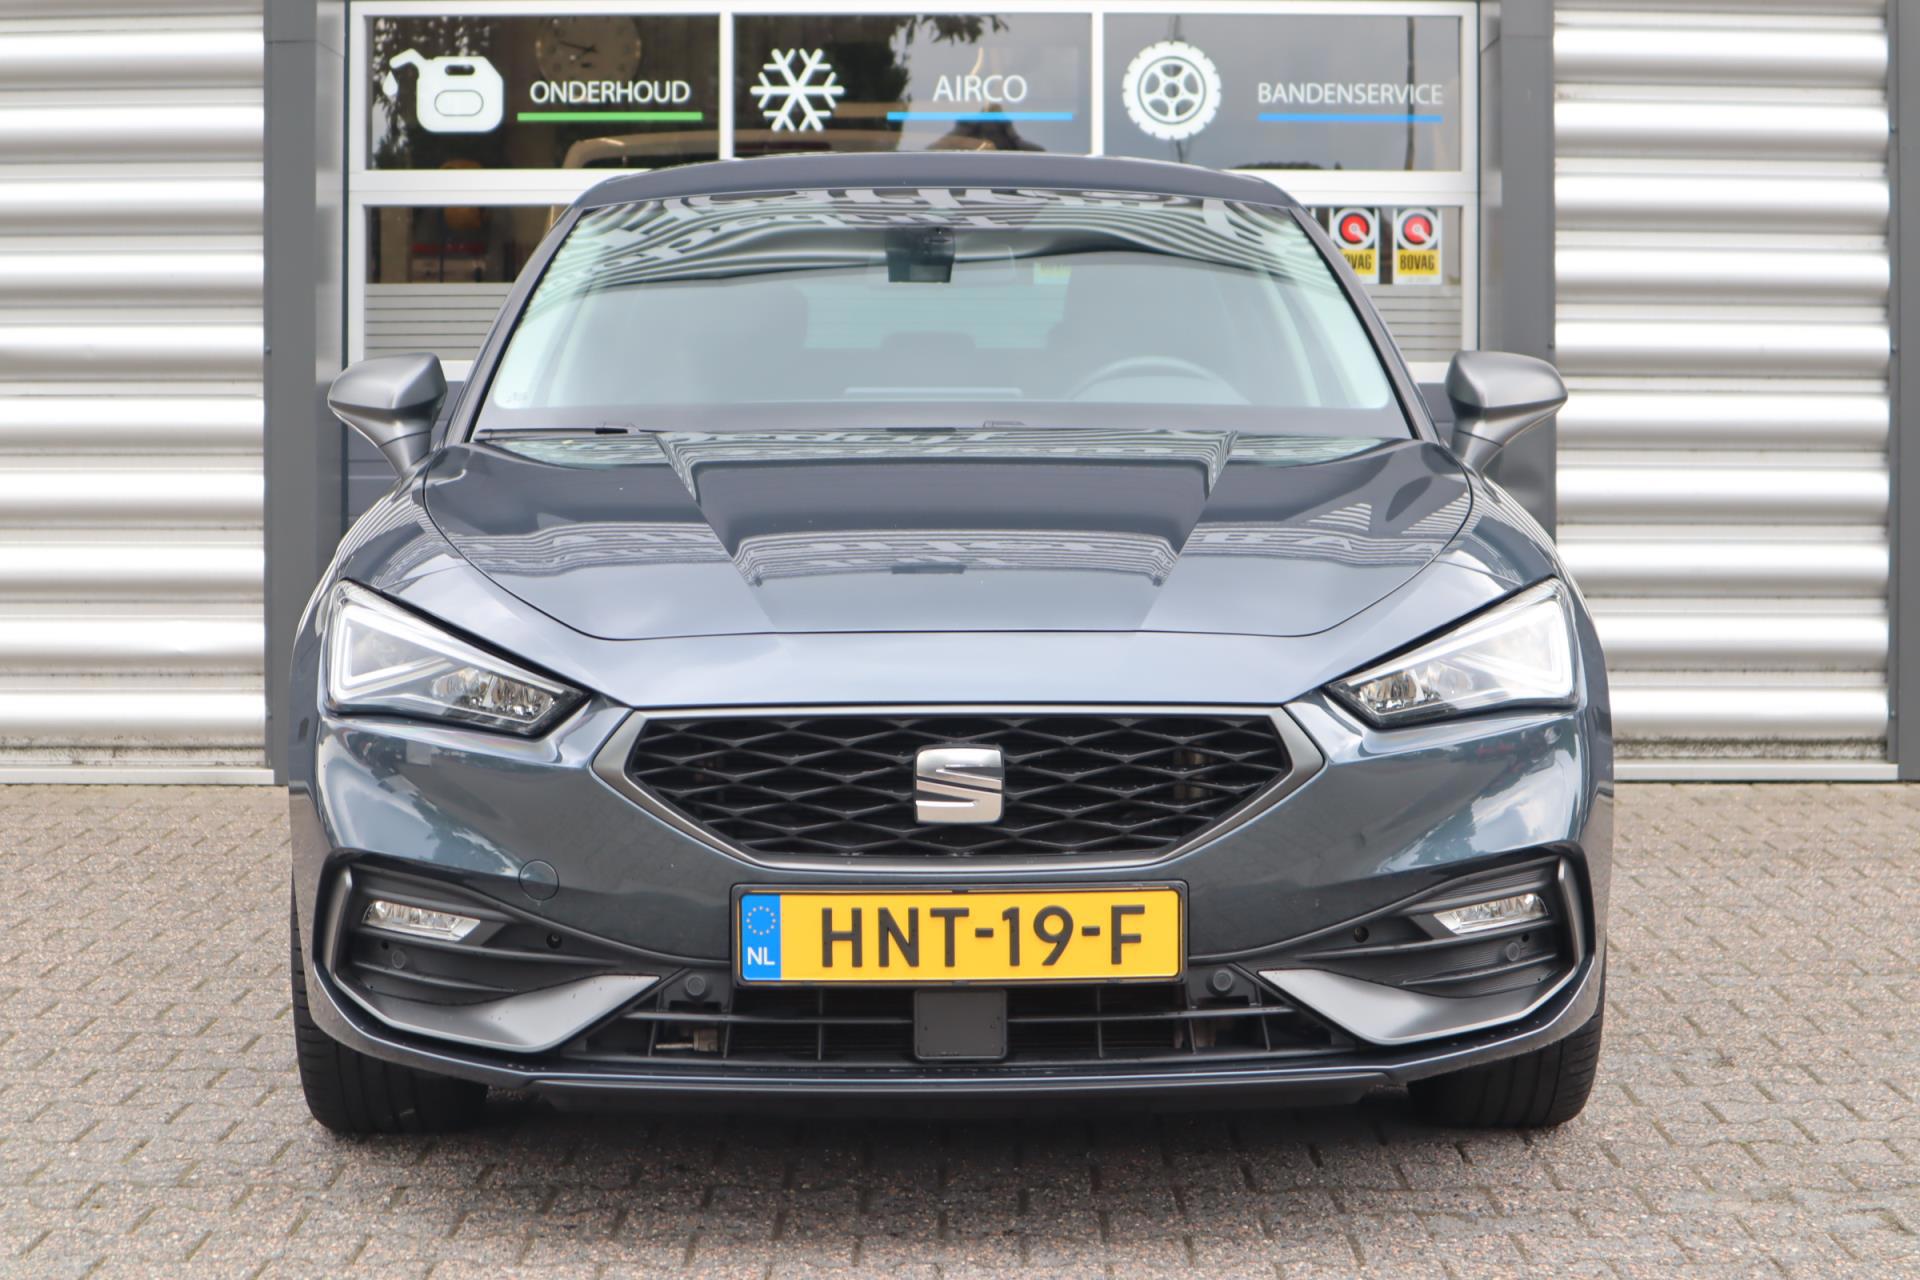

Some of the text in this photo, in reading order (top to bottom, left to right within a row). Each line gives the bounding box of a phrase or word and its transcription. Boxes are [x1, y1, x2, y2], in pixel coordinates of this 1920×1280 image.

[529, 80, 691, 104] ONDERHOUD
[932, 74, 1028, 103] AIRCO
[1257, 82, 1444, 105] BANDENSERVICE
[1400, 254, 1435, 270] BOVAG
[821, 904, 1146, 968] HNT-19-F
[747, 946, 776, 966] NL
